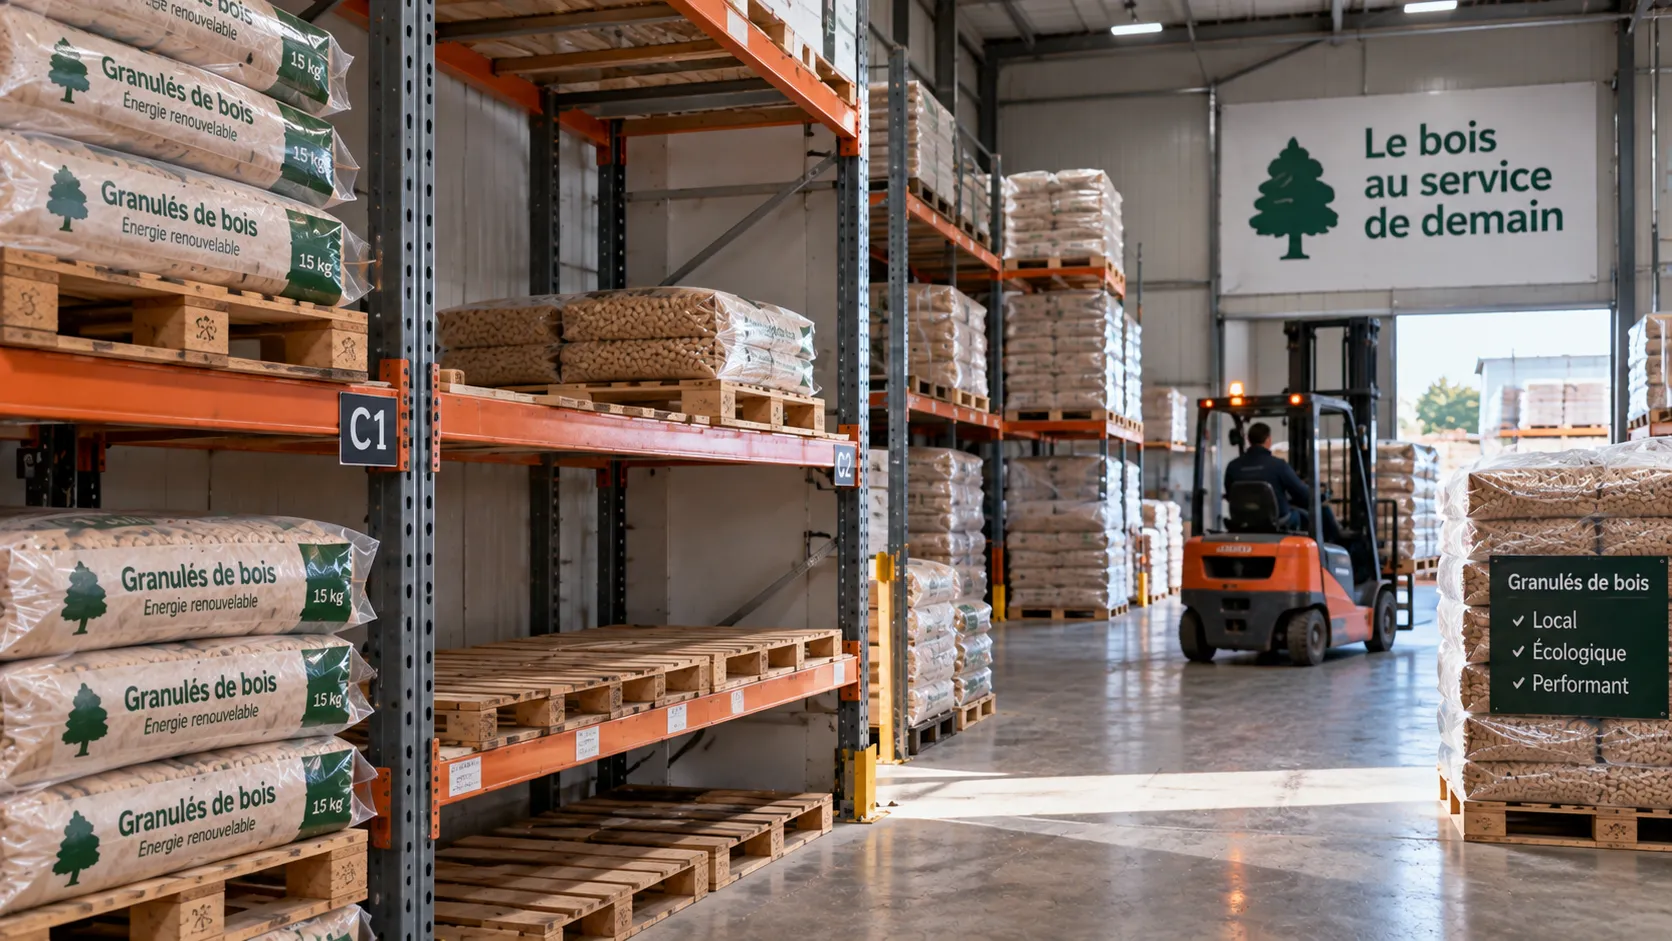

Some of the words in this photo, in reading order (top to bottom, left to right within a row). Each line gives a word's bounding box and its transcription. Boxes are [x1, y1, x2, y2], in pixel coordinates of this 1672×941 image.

[170, 3, 237, 41] renouvelable
[291, 51, 305, 70] 15
[307, 58, 323, 81] kg
[101, 55, 187, 102] Granulés
[191, 85, 213, 111] de
[216, 92, 254, 125] bois
[123, 90, 167, 120] Énergie
[169, 110, 238, 142] renouvelable
[1365, 127, 1407, 159] Le
[1419, 120, 1497, 156] bois
[293, 145, 308, 163] 15
[1364, 173, 1408, 199] au
[1420, 160, 1552, 196] service
[101, 180, 189, 222] Granulés
[193, 202, 216, 228] de
[221, 207, 258, 237] bois
[1364, 206, 1410, 240] de
[1421, 199, 1564, 237] demain
[170, 230, 240, 257] renouvelable
[299, 253, 315, 270] 15
[317, 256, 333, 278] kg
[349, 406, 387, 451] C1
[837, 451, 852, 479] C2
[121, 562, 208, 593] Granulés
[213, 561, 235, 586] de
[238, 560, 277, 585] bois
[1508, 572, 1583, 591] Granulés
[1587, 573, 1609, 591] de
[1614, 573, 1650, 591] bois
[190, 593, 258, 613] renouvelable
[313, 588, 328, 603] 15
[329, 588, 344, 607] kg
[1533, 610, 1577, 629] Local
[1533, 638, 1627, 666] Écologique
[124, 677, 210, 712] Granulés
[214, 674, 237, 700] de
[240, 669, 277, 696] bois
[1533, 673, 1629, 695] Performant
[313, 692, 328, 708] 15
[329, 691, 343, 709] kg
[191, 703, 259, 727] renouvelable
[118, 795, 207, 837] Granulés
[212, 790, 234, 816] de
[238, 781, 276, 810] bois
[312, 798, 327, 815] 15
[329, 796, 344, 814] kg
[187, 816, 256, 845] renouvelable
